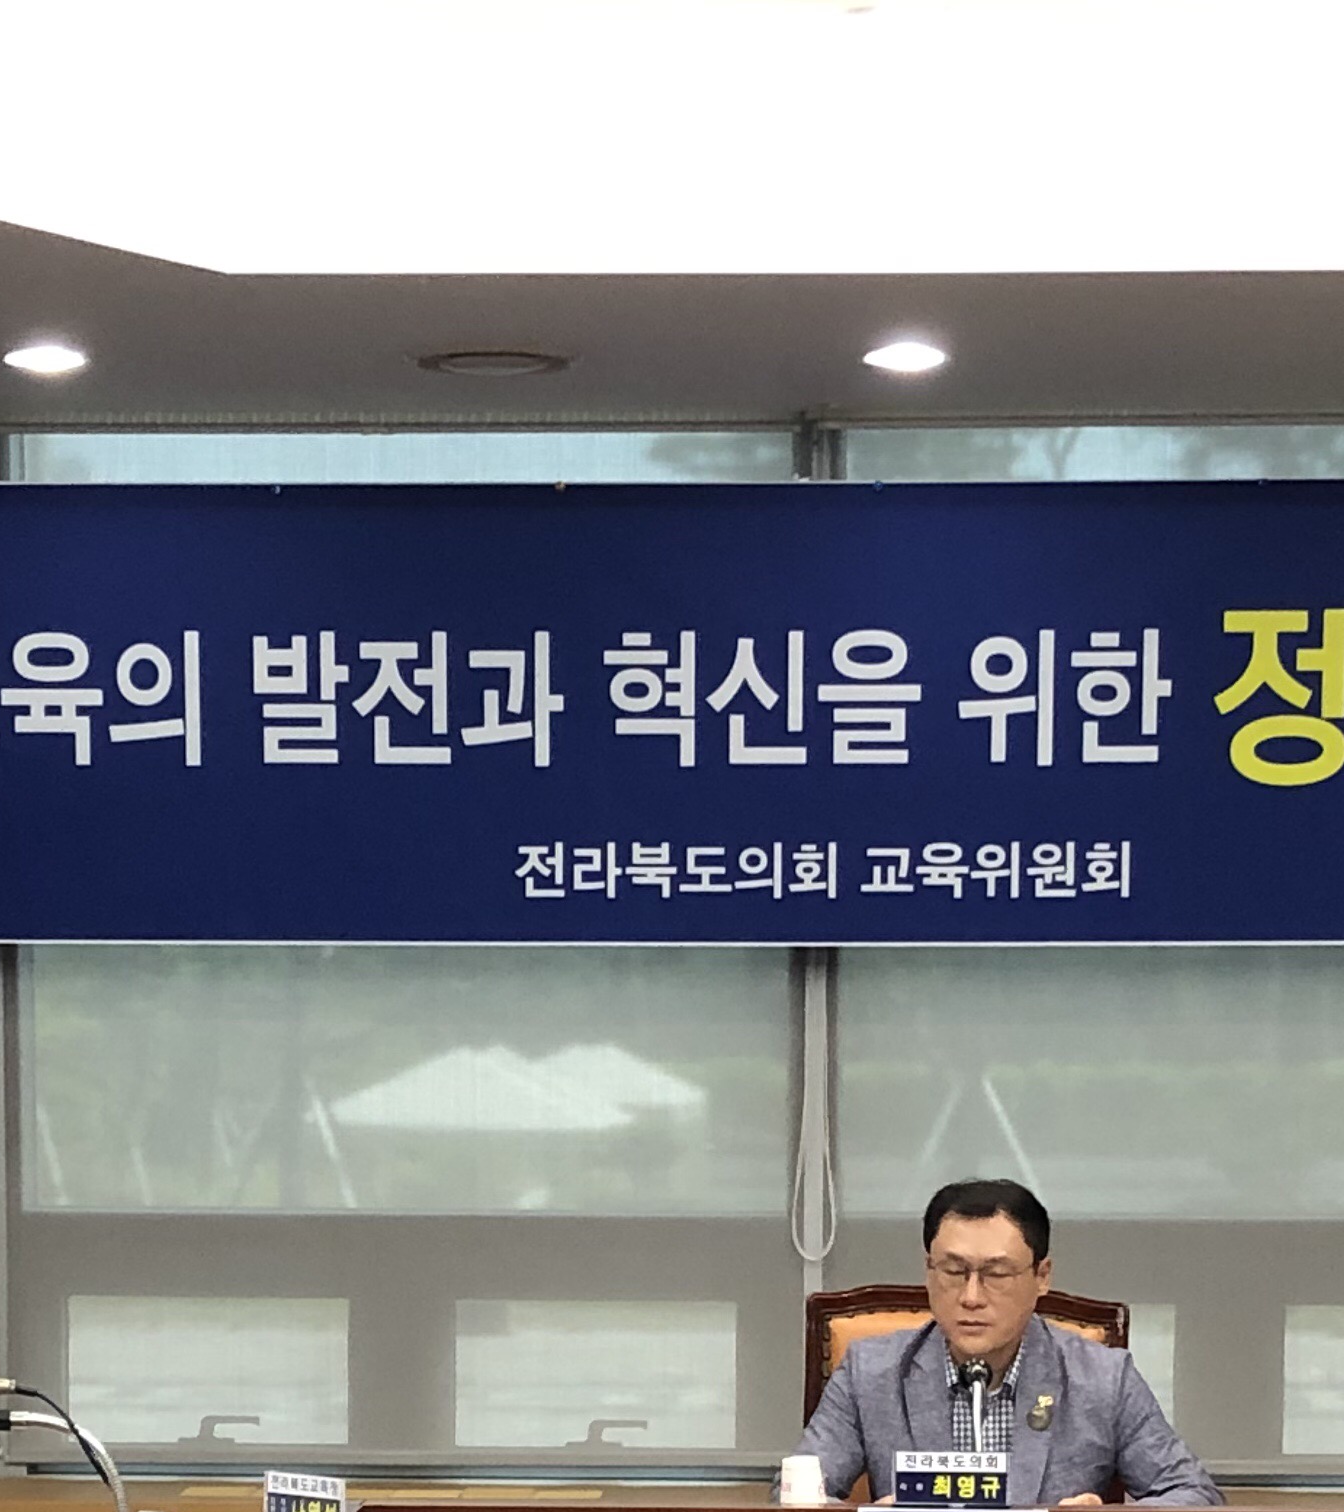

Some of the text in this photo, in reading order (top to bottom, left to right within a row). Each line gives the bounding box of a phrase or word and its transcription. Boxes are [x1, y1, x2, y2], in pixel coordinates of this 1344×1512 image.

[252, 630, 565, 767] 발전과
[603, 629, 922, 768] 혁신을
[958, 628, 1173, 767] 위한
[514, 840, 1132, 899] 전라북도의회 교육위원회
[904, 1454, 998, 1468] 전라북도의회
[932, 1475, 1000, 1499] 최영규
